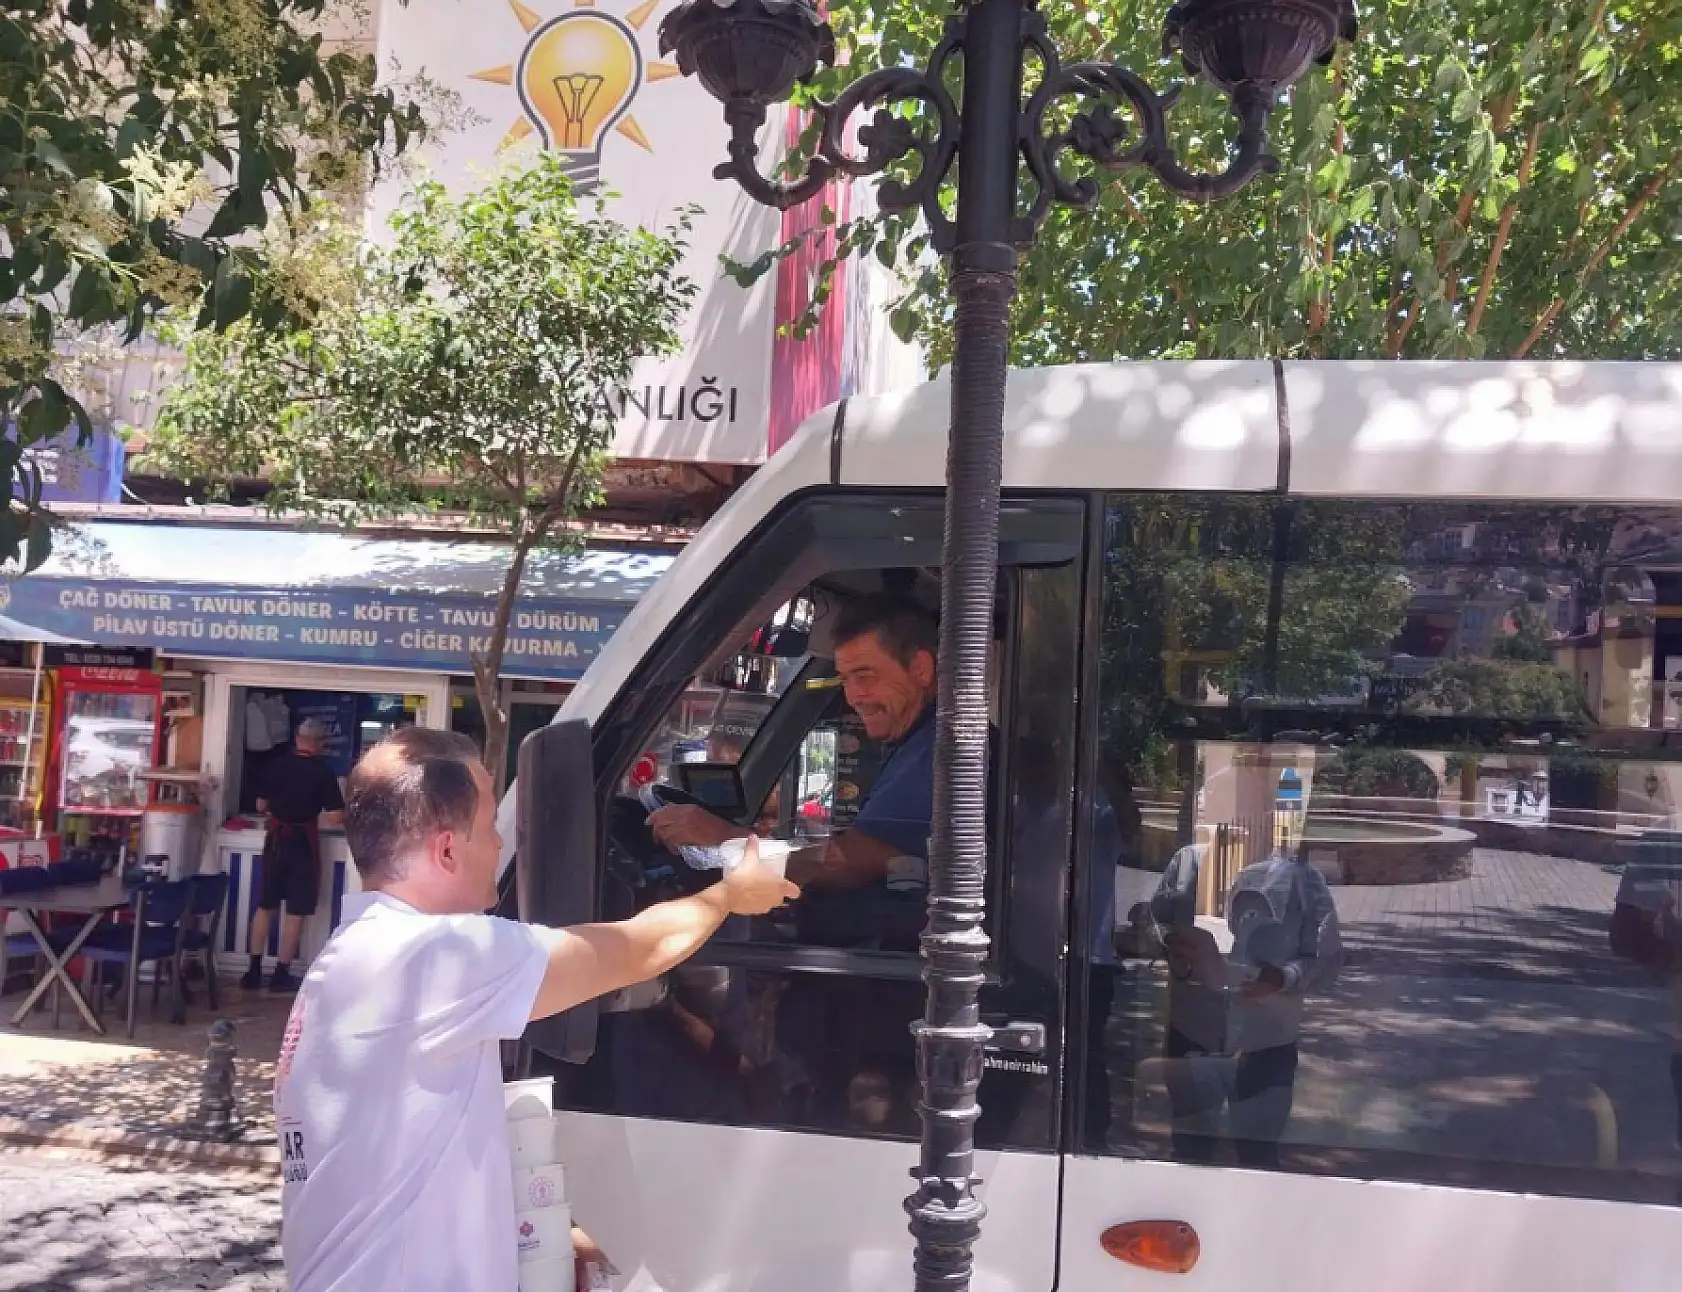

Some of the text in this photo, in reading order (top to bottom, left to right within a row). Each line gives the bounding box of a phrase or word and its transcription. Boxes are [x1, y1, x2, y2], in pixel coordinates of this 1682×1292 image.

[59, 587, 100, 609] ÇAĞ
[104, 588, 172, 611] DÖNER
[191, 596, 257, 616] TAVUK
[262, 597, 331, 619] DÖNER
[353, 601, 420, 623] KÖFTE
[439, 607, 511, 628] TAVU
[517, 611, 599, 632] DÜRÜM
[93, 614, 148, 635] PİLAV
[154, 616, 204, 638] ÜSTÜ
[210, 620, 279, 642] DÖNER
[301, 627, 377, 647] KUMRU
[400, 631, 462, 652] CİĞER
